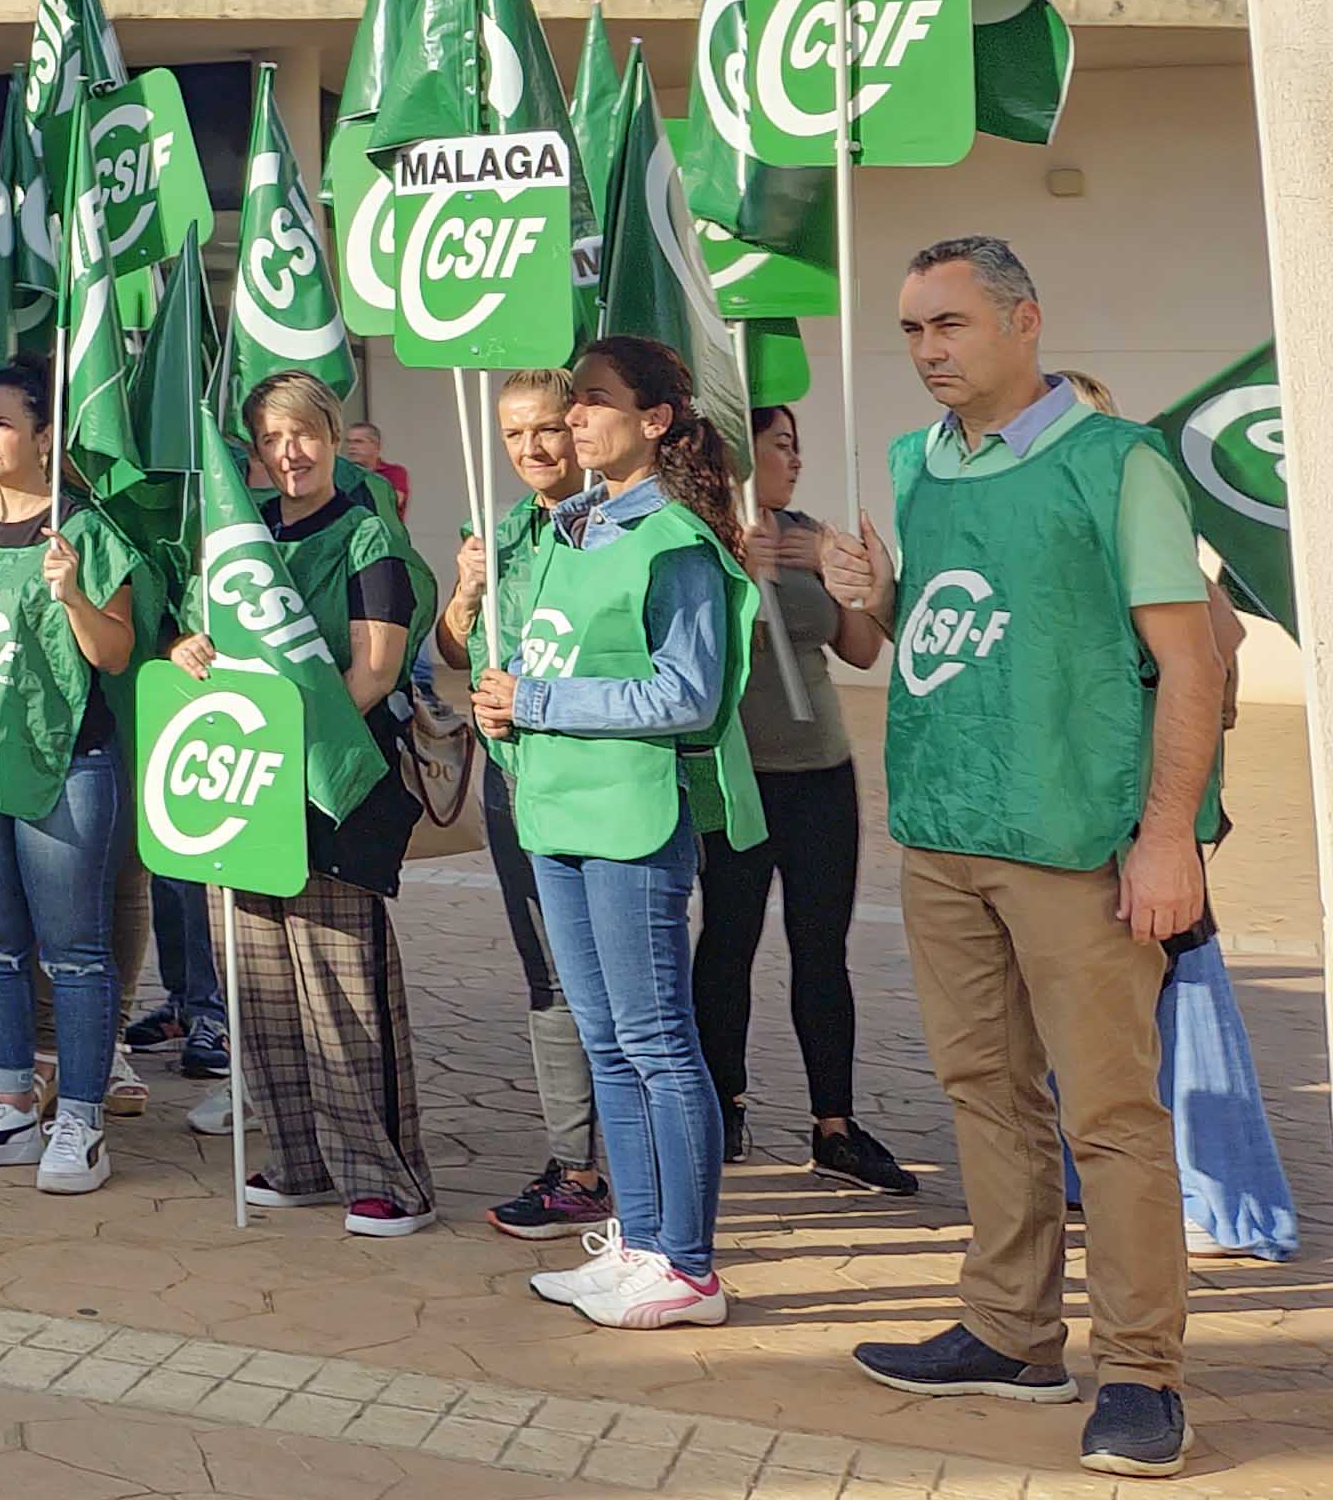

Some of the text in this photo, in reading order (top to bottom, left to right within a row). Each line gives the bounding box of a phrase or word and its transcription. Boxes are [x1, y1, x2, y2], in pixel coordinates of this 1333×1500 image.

[399, 140, 565, 187] MÁLAGA
[250, 185, 318, 311] CSI
[426, 216, 547, 280] CSIF
[209, 558, 334, 665] CSIF
[170, 739, 284, 806] CSIF
